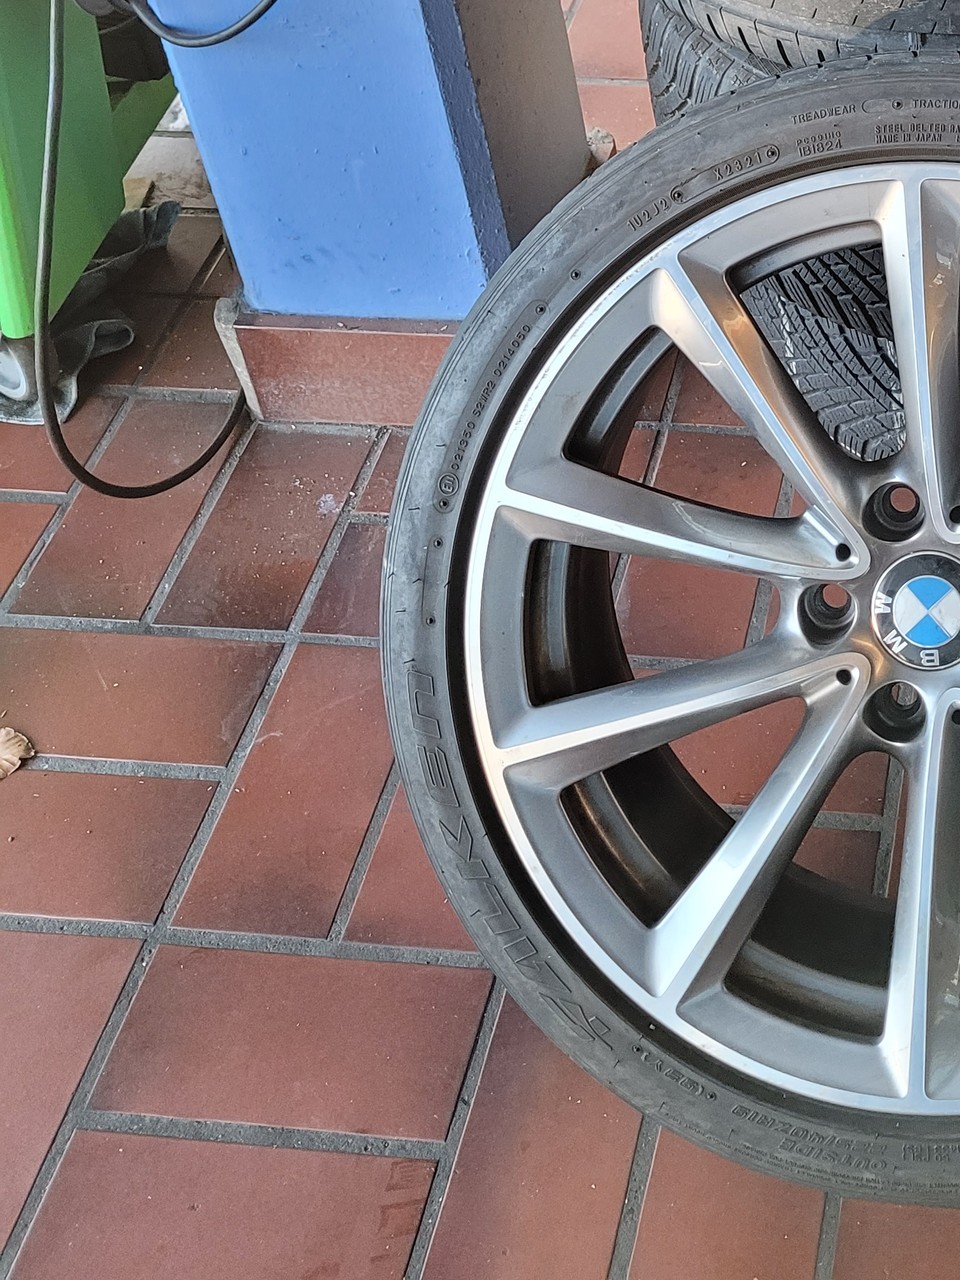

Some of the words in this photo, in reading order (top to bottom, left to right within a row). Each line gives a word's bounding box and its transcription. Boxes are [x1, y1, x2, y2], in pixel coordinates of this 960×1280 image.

[791, 103, 857, 125] TREADWEAR
[874, 123, 906, 134] STEEL
[874, 133, 900, 144] MADE
[902, 133, 912, 143] IN
[914, 133, 943, 143] JAPAN
[712, 151, 764, 182] X2321
[874, 590, 940, 666] BMW
[404, 668, 613, 1050] FALKEN
